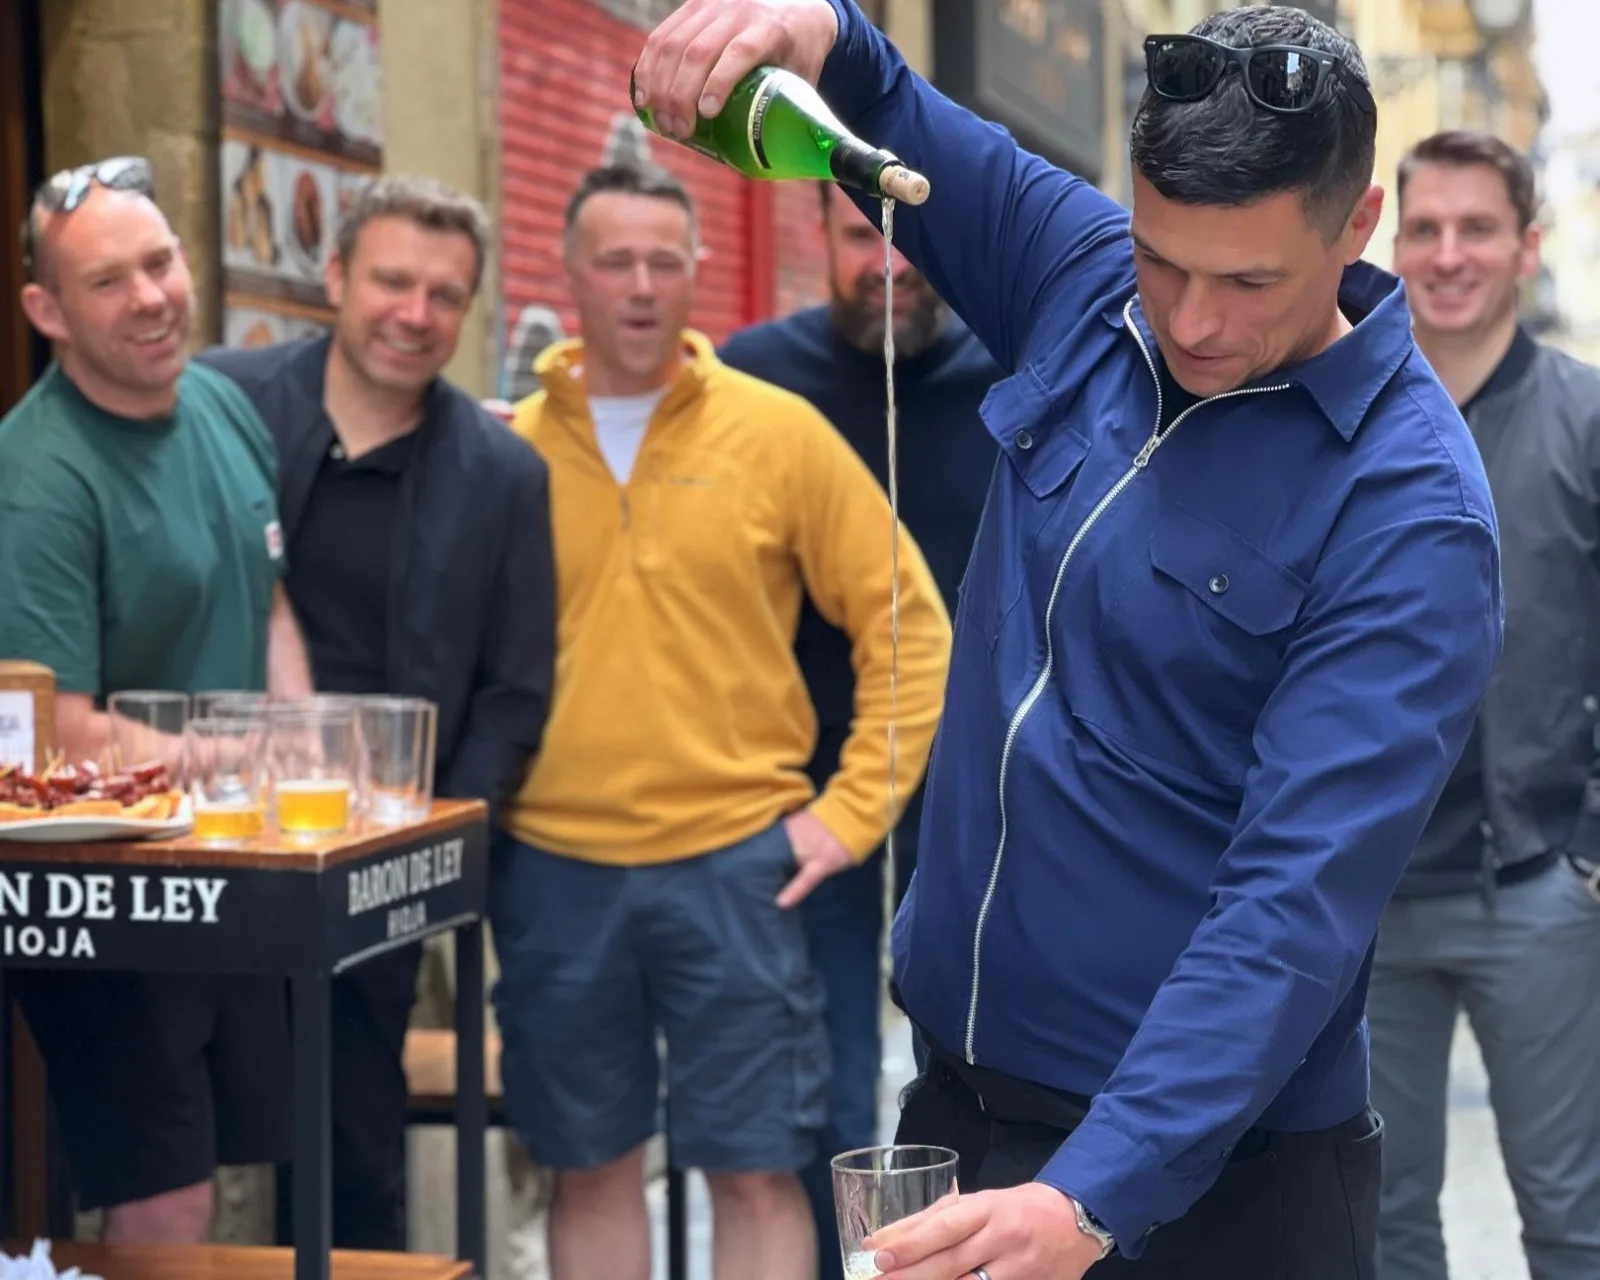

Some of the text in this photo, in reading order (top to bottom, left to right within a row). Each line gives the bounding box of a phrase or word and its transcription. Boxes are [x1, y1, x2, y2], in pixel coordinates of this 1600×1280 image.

[45, 873, 116, 919] DE
[129, 876, 228, 923] LEY
[348, 837, 464, 916] BARON DE LEY
